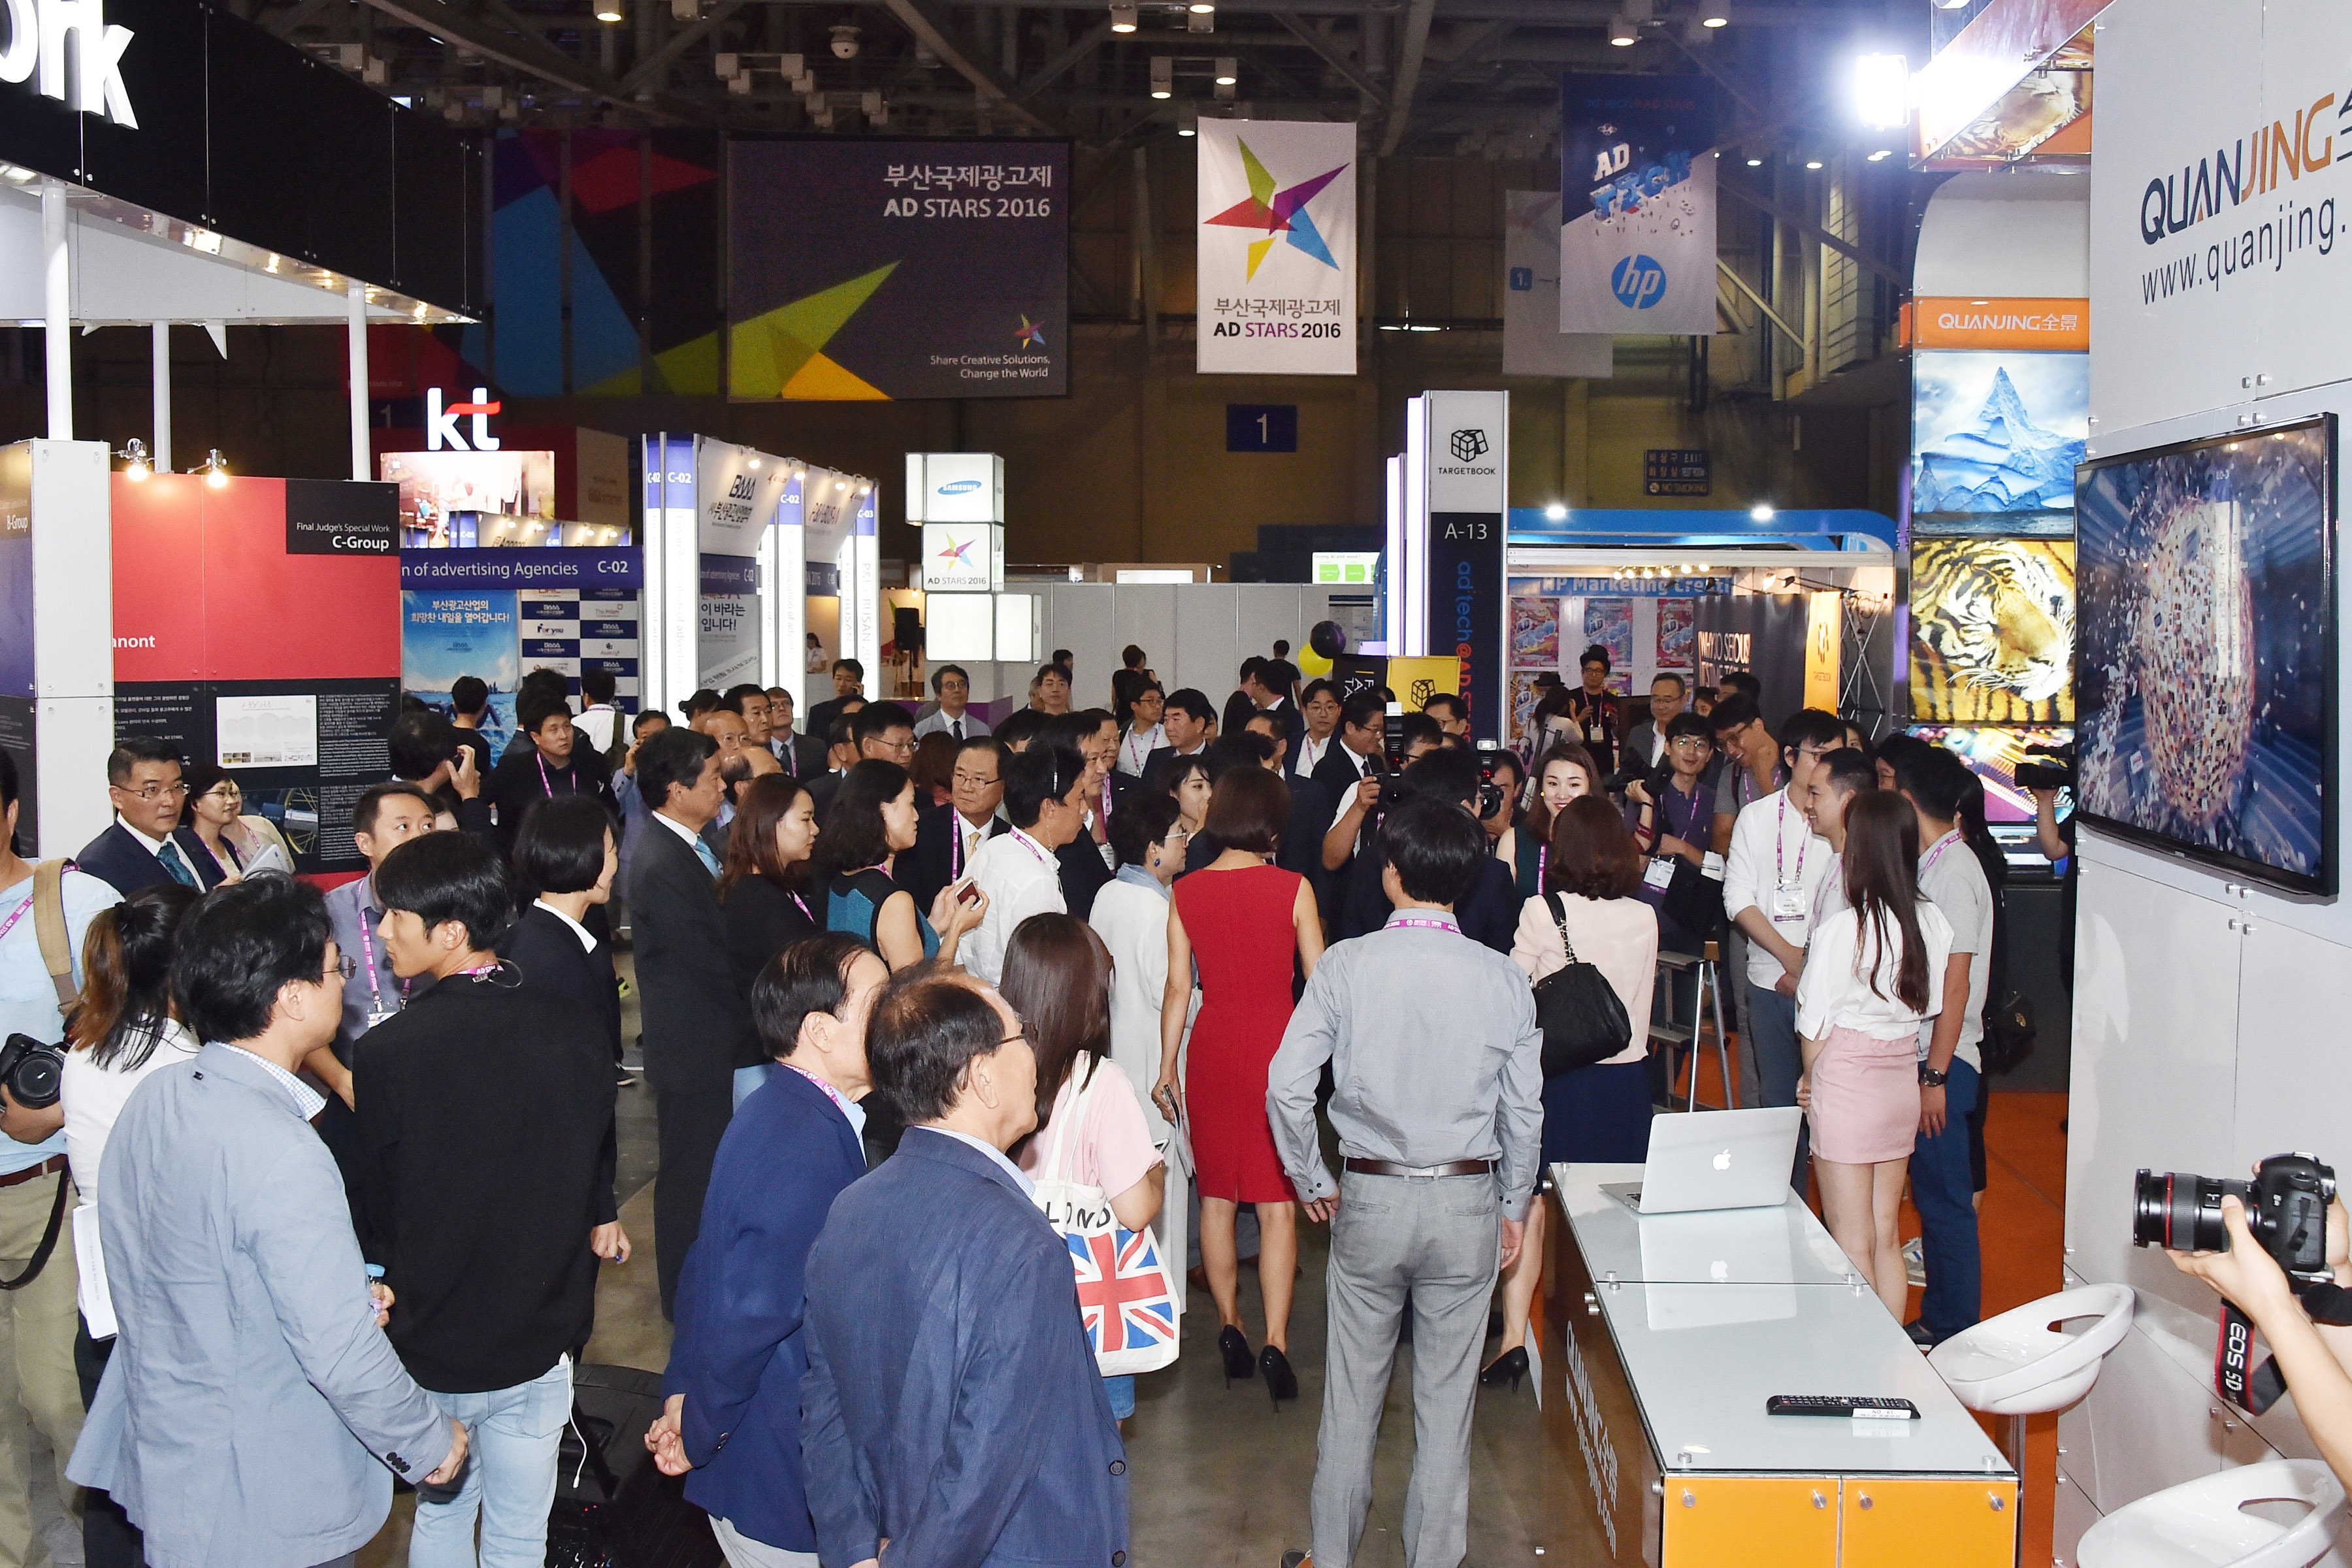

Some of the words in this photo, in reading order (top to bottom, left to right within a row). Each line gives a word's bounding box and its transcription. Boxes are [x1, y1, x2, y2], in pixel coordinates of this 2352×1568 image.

[1593, 142, 1630, 181] AD
[883, 165, 1053, 191] 부산국제광고제
[883, 199, 918, 218] AD
[924, 199, 992, 218] STARS
[997, 199, 1051, 218] 2016
[1618, 257, 1661, 308] hp
[1213, 297, 1341, 318] 부산국제광고제
[1213, 323, 1241, 338] AD
[1245, 323, 1298, 338] STARS
[1301, 323, 1341, 338] 2016
[930, 354, 957, 366] Share
[960, 354, 1000, 366] Creative
[960, 368, 998, 381] Change
[1002, 368, 1017, 378] the
[1020, 368, 1048, 378] World
[427, 387, 501, 451] kt
[1256, 414, 1268, 444] 1
[667, 472, 692, 483] C-02
[943, 483, 977, 492] SAMSUNG
[780, 495, 800, 504] C-02
[857, 509, 874, 518] C-03
[7, 514, 28, 532] B-Group
[297, 523, 314, 531] Final
[316, 523, 342, 533] Judge's
[344, 523, 370, 533] Special
[1444, 523, 1487, 540] A-13
[332, 535, 389, 552] C-Group
[414, 562, 429, 576] of
[431, 562, 510, 580] advertising
[514, 562, 578, 579] Agencies
[598, 561, 629, 574] C-02
[1543, 578, 1567, 591] HP
[1573, 578, 1666, 595] Marketing
[432, 600, 489, 610] 부산광고산업의
[702, 603, 712, 615] 이
[714, 603, 745, 617] 바라는
[438, 613, 463, 623] 내일을
[465, 613, 510, 623] 열어갑니다!
[702, 618, 737, 632] 입니다!
[1045, 1201, 1111, 1229] LOND
[2227, 1322, 2246, 1369] EOS
